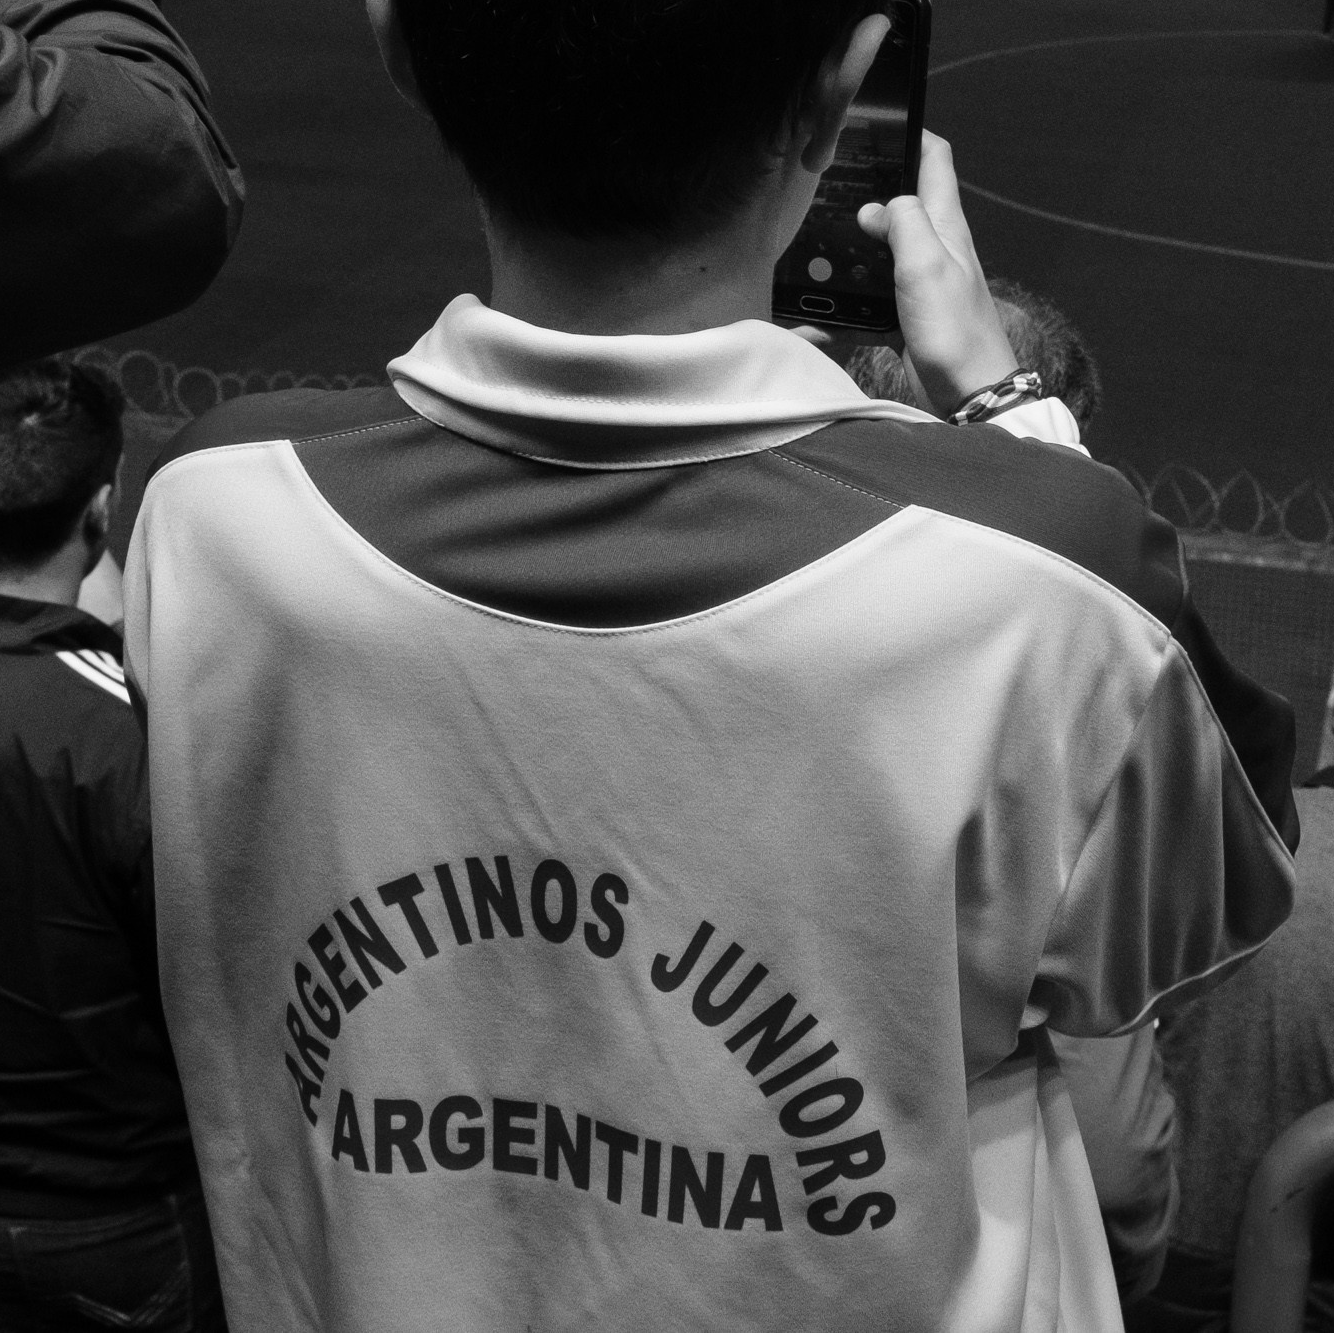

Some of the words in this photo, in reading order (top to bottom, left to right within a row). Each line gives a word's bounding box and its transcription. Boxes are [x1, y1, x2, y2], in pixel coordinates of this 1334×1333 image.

[284, 854, 630, 1128] ARGENTINOS
[649, 919, 897, 1237] JUNIORS
[330, 1087, 784, 1233] ARGENTINA
